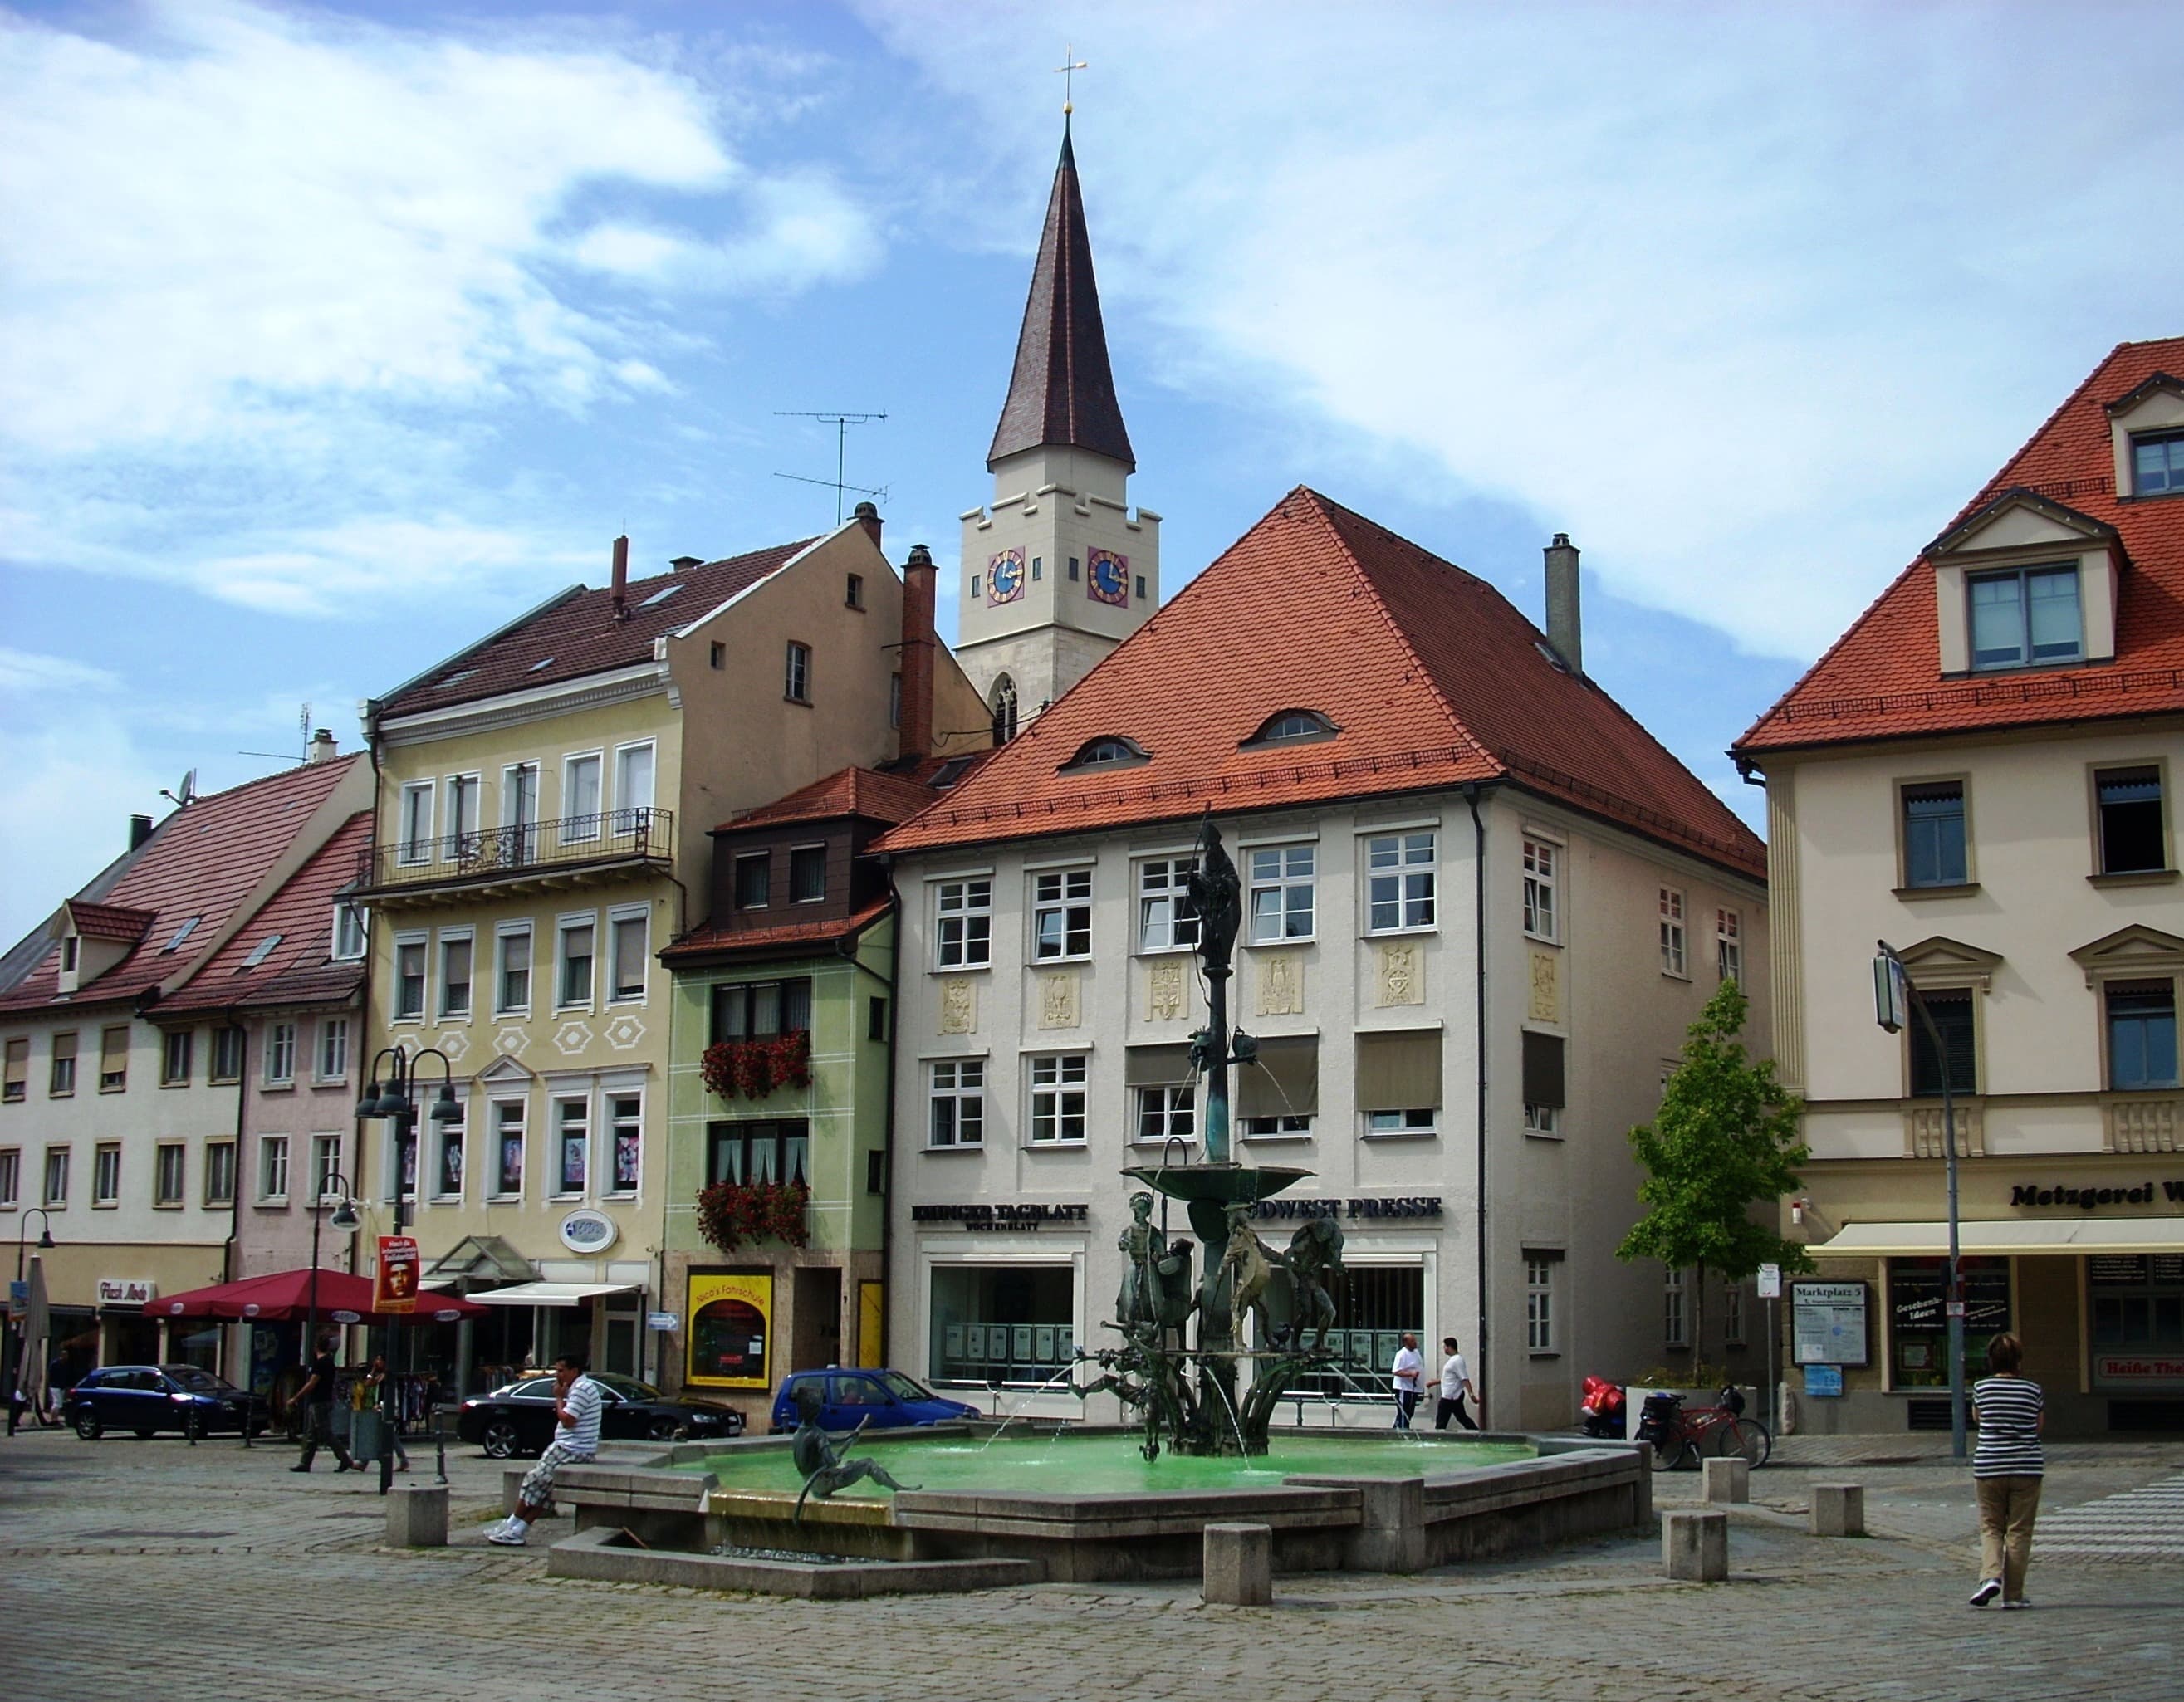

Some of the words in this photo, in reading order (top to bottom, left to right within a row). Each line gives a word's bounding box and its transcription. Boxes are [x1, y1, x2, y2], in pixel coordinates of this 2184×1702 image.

[2010, 1182, 2153, 1209] Metzgerei
[995, 1204, 1089, 1220] TAGBLATT
[1346, 1197, 1442, 1218] PRESSE
[966, 1222, 1038, 1230] WOCHENBLATT
[697, 1286, 719, 1304] Nico's
[722, 1285, 765, 1307] Fahrschule
[1797, 1288, 1852, 1298] Marktplatz
[1910, 1308, 1937, 1320] Ideen
[2107, 1362, 2152, 1374] Heiße
